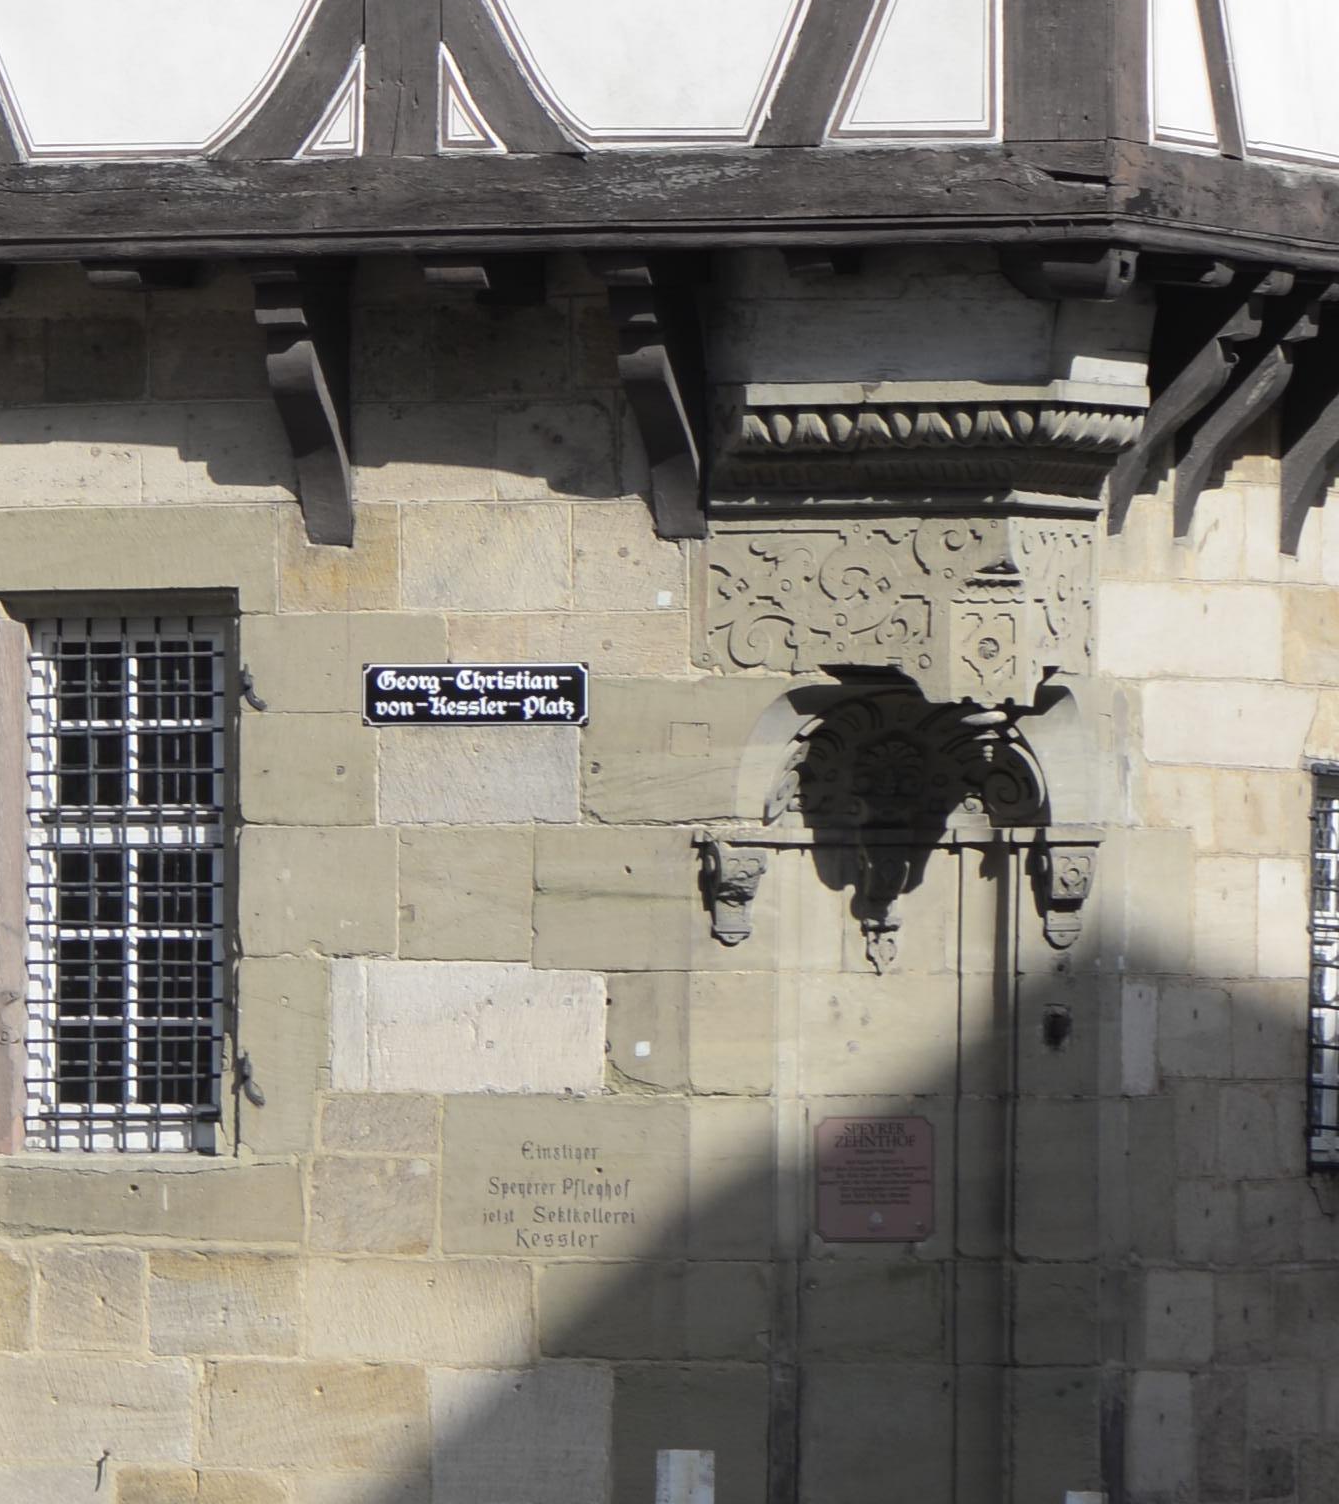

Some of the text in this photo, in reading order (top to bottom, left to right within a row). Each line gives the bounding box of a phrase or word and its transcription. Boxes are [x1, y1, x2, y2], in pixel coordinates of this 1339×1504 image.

[376, 670, 572, 694] Georg-Christian-
[375, 696, 575, 720] von-Kessler-Platz
[522, 1140, 600, 1164] Einstiger
[563, 1177, 631, 1201] Pfleghof
[532, 1205, 636, 1224] Sektkellerei
[516, 1228, 600, 1249] Kessler
